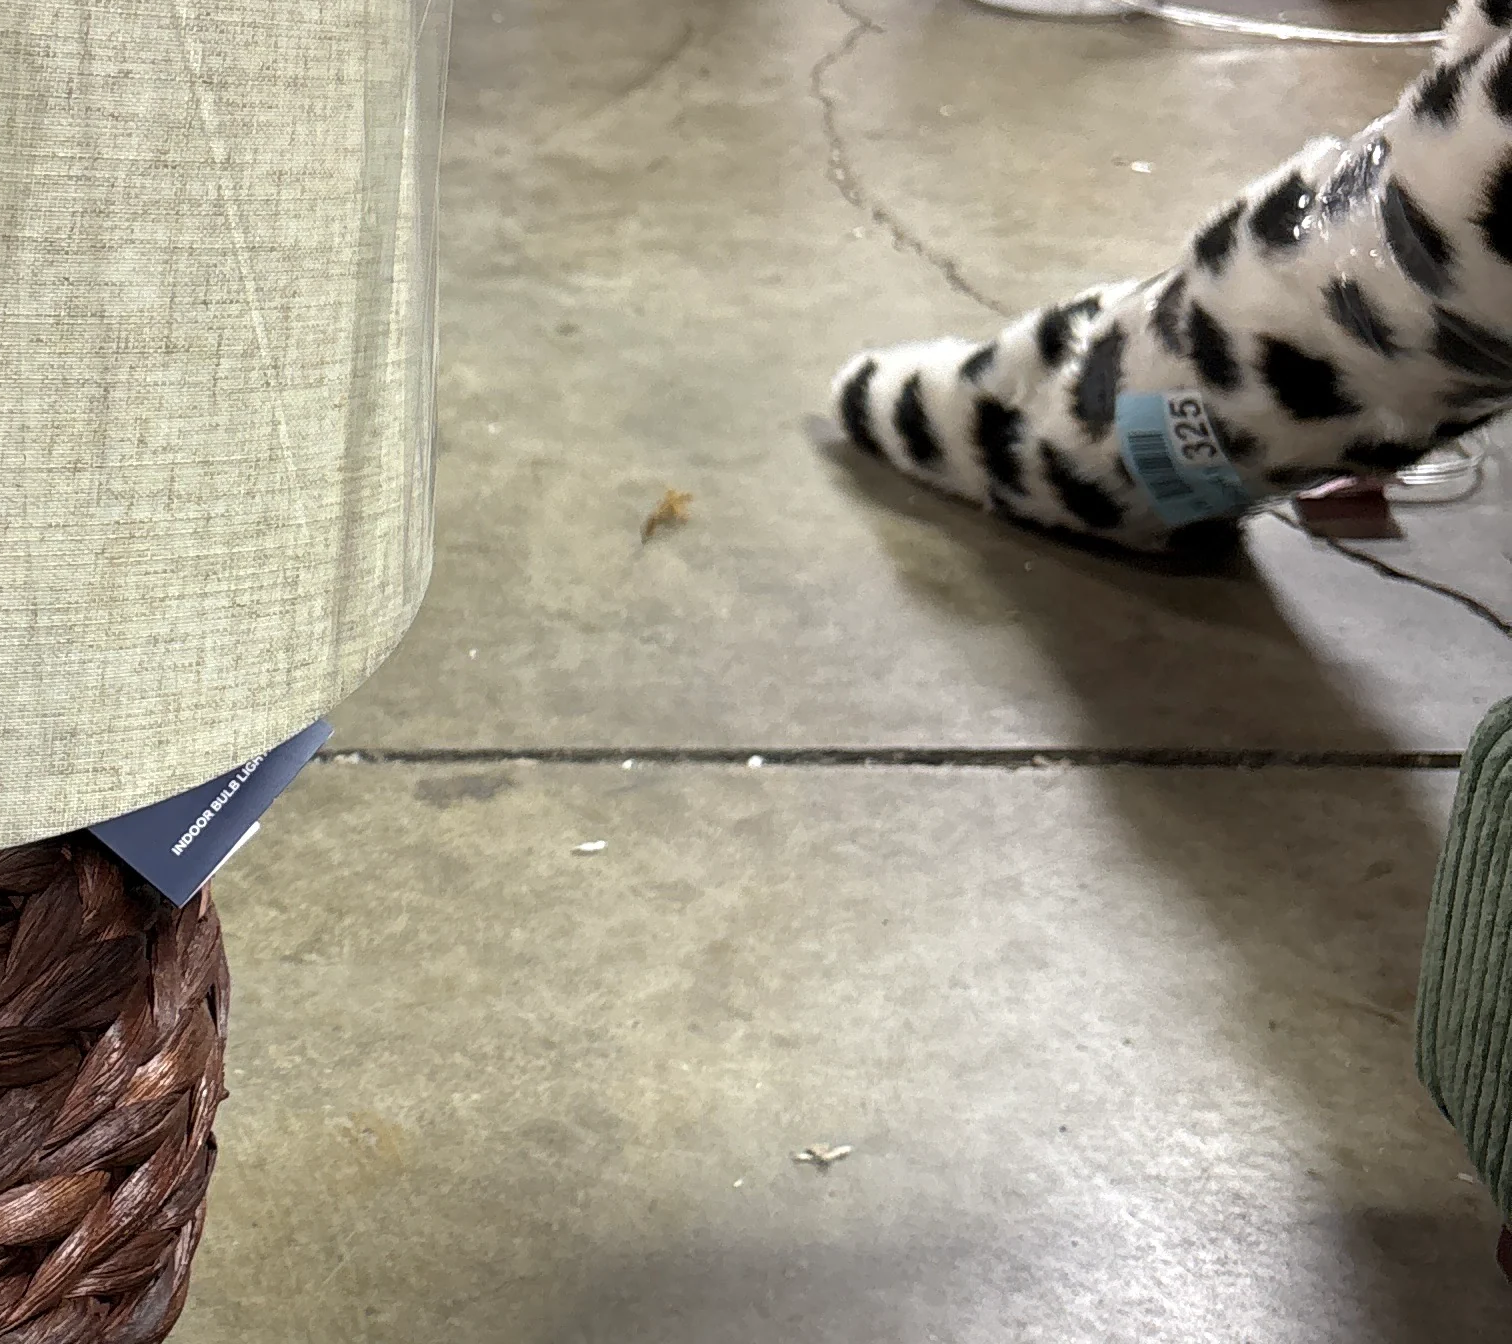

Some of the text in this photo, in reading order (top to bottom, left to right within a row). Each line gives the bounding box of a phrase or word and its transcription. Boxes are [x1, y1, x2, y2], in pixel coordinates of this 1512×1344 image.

[1169, 399, 1217, 459] 325
[171, 809, 215, 856] INDOOR
[210, 779, 240, 812] BULB
